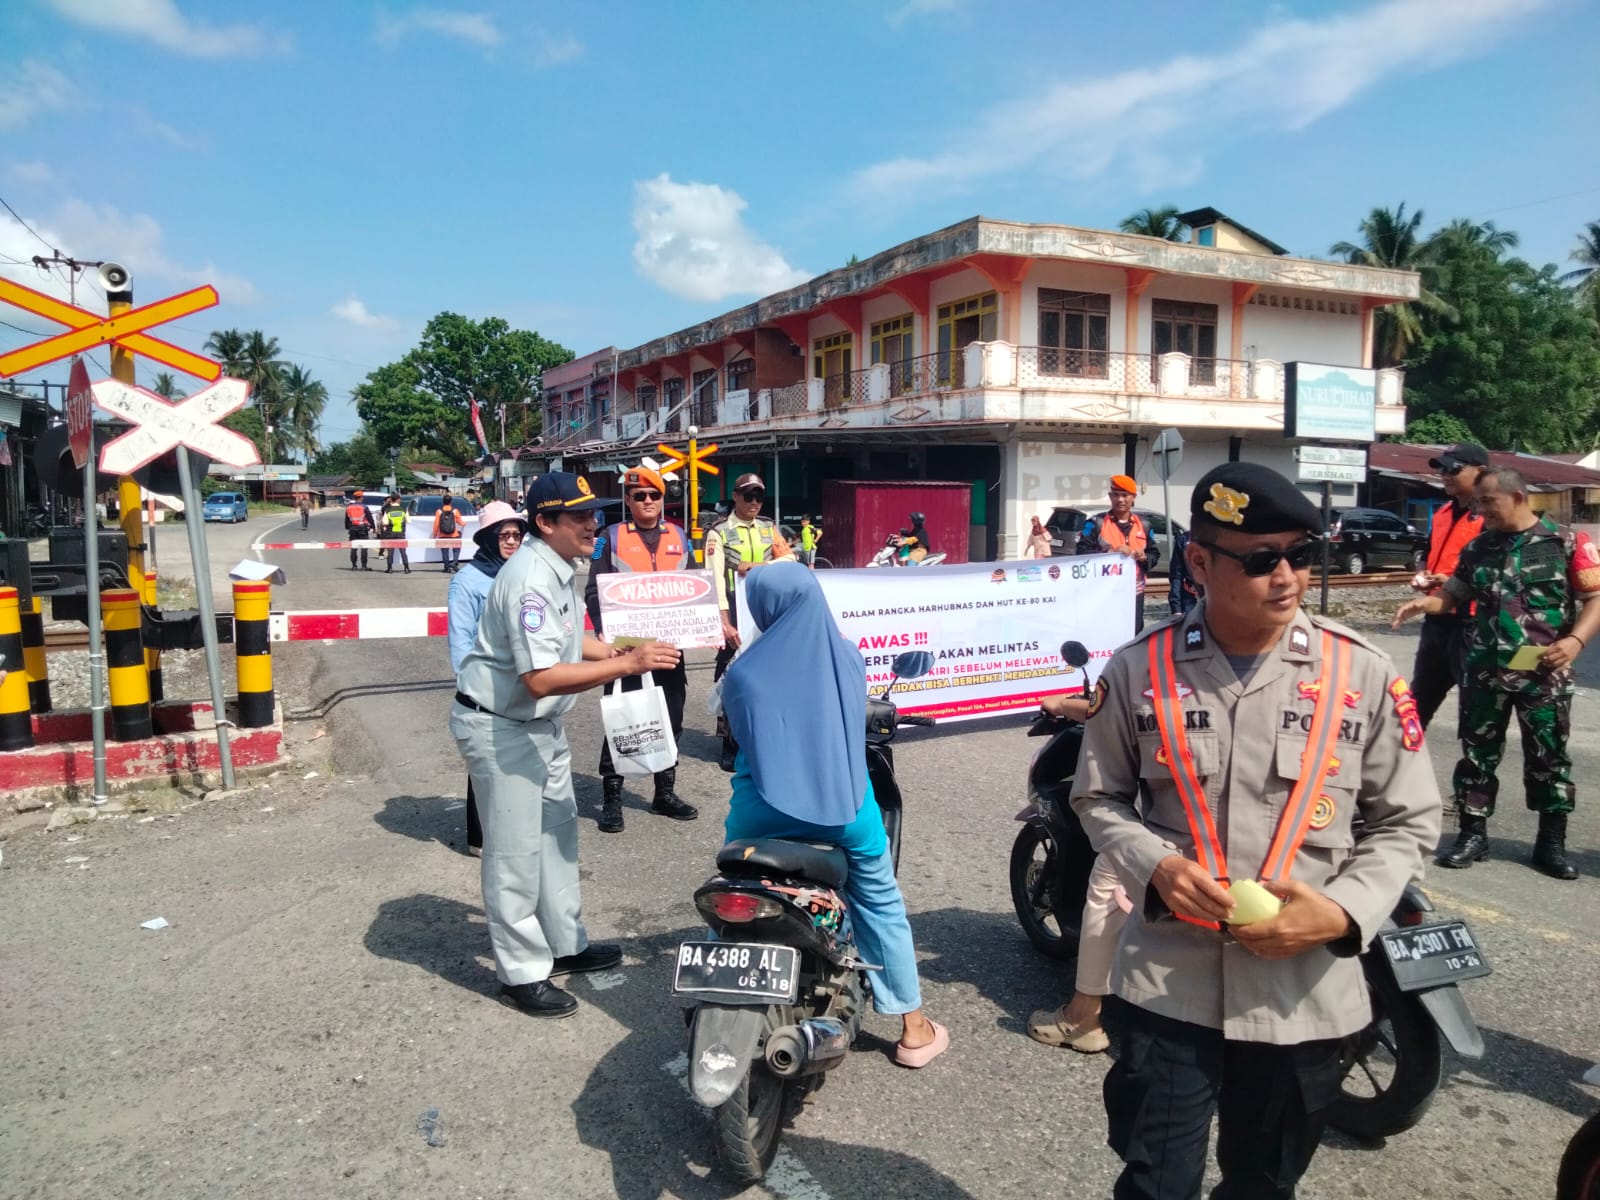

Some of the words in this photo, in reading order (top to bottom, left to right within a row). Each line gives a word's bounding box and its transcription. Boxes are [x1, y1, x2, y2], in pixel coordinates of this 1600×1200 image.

[68, 389, 91, 437] STOP
[620, 580, 696, 601] WARNING
[627, 608, 696, 620] KESELAMATAN
[842, 609, 876, 619] DALAM
[878, 606, 916, 616] RANGKA
[918, 601, 974, 613] HARHUBNAS
[976, 600, 994, 609] DAN
[997, 599, 1013, 607] HUT
[1016, 597, 1040, 605] KE-80
[616, 619, 681, 632] PERLINTASAN
[683, 615, 719, 627] ADALAH
[659, 627, 690, 638] UNTUK
[858, 633, 910, 650] AWAS
[914, 632, 928, 645] !!!
[938, 647, 974, 660] AKAN
[979, 641, 1039, 656] MELINTAS
[928, 665, 950, 676] KIRI
[953, 660, 1001, 674] SEBELUM
[1005, 655, 1058, 669] MELEWATI
[869, 685, 888, 696] API
[891, 681, 924, 694] TIDAK
[926, 677, 951, 690] BISA
[953, 673, 1001, 687] BERHENTI
[1282, 710, 1363, 741] PORI
[1387, 938, 1411, 959] BA
[1413, 932, 1450, 954] 2901
[681, 945, 703, 966] BA
[706, 947, 750, 968] 4388
[759, 950, 781, 971] AL
